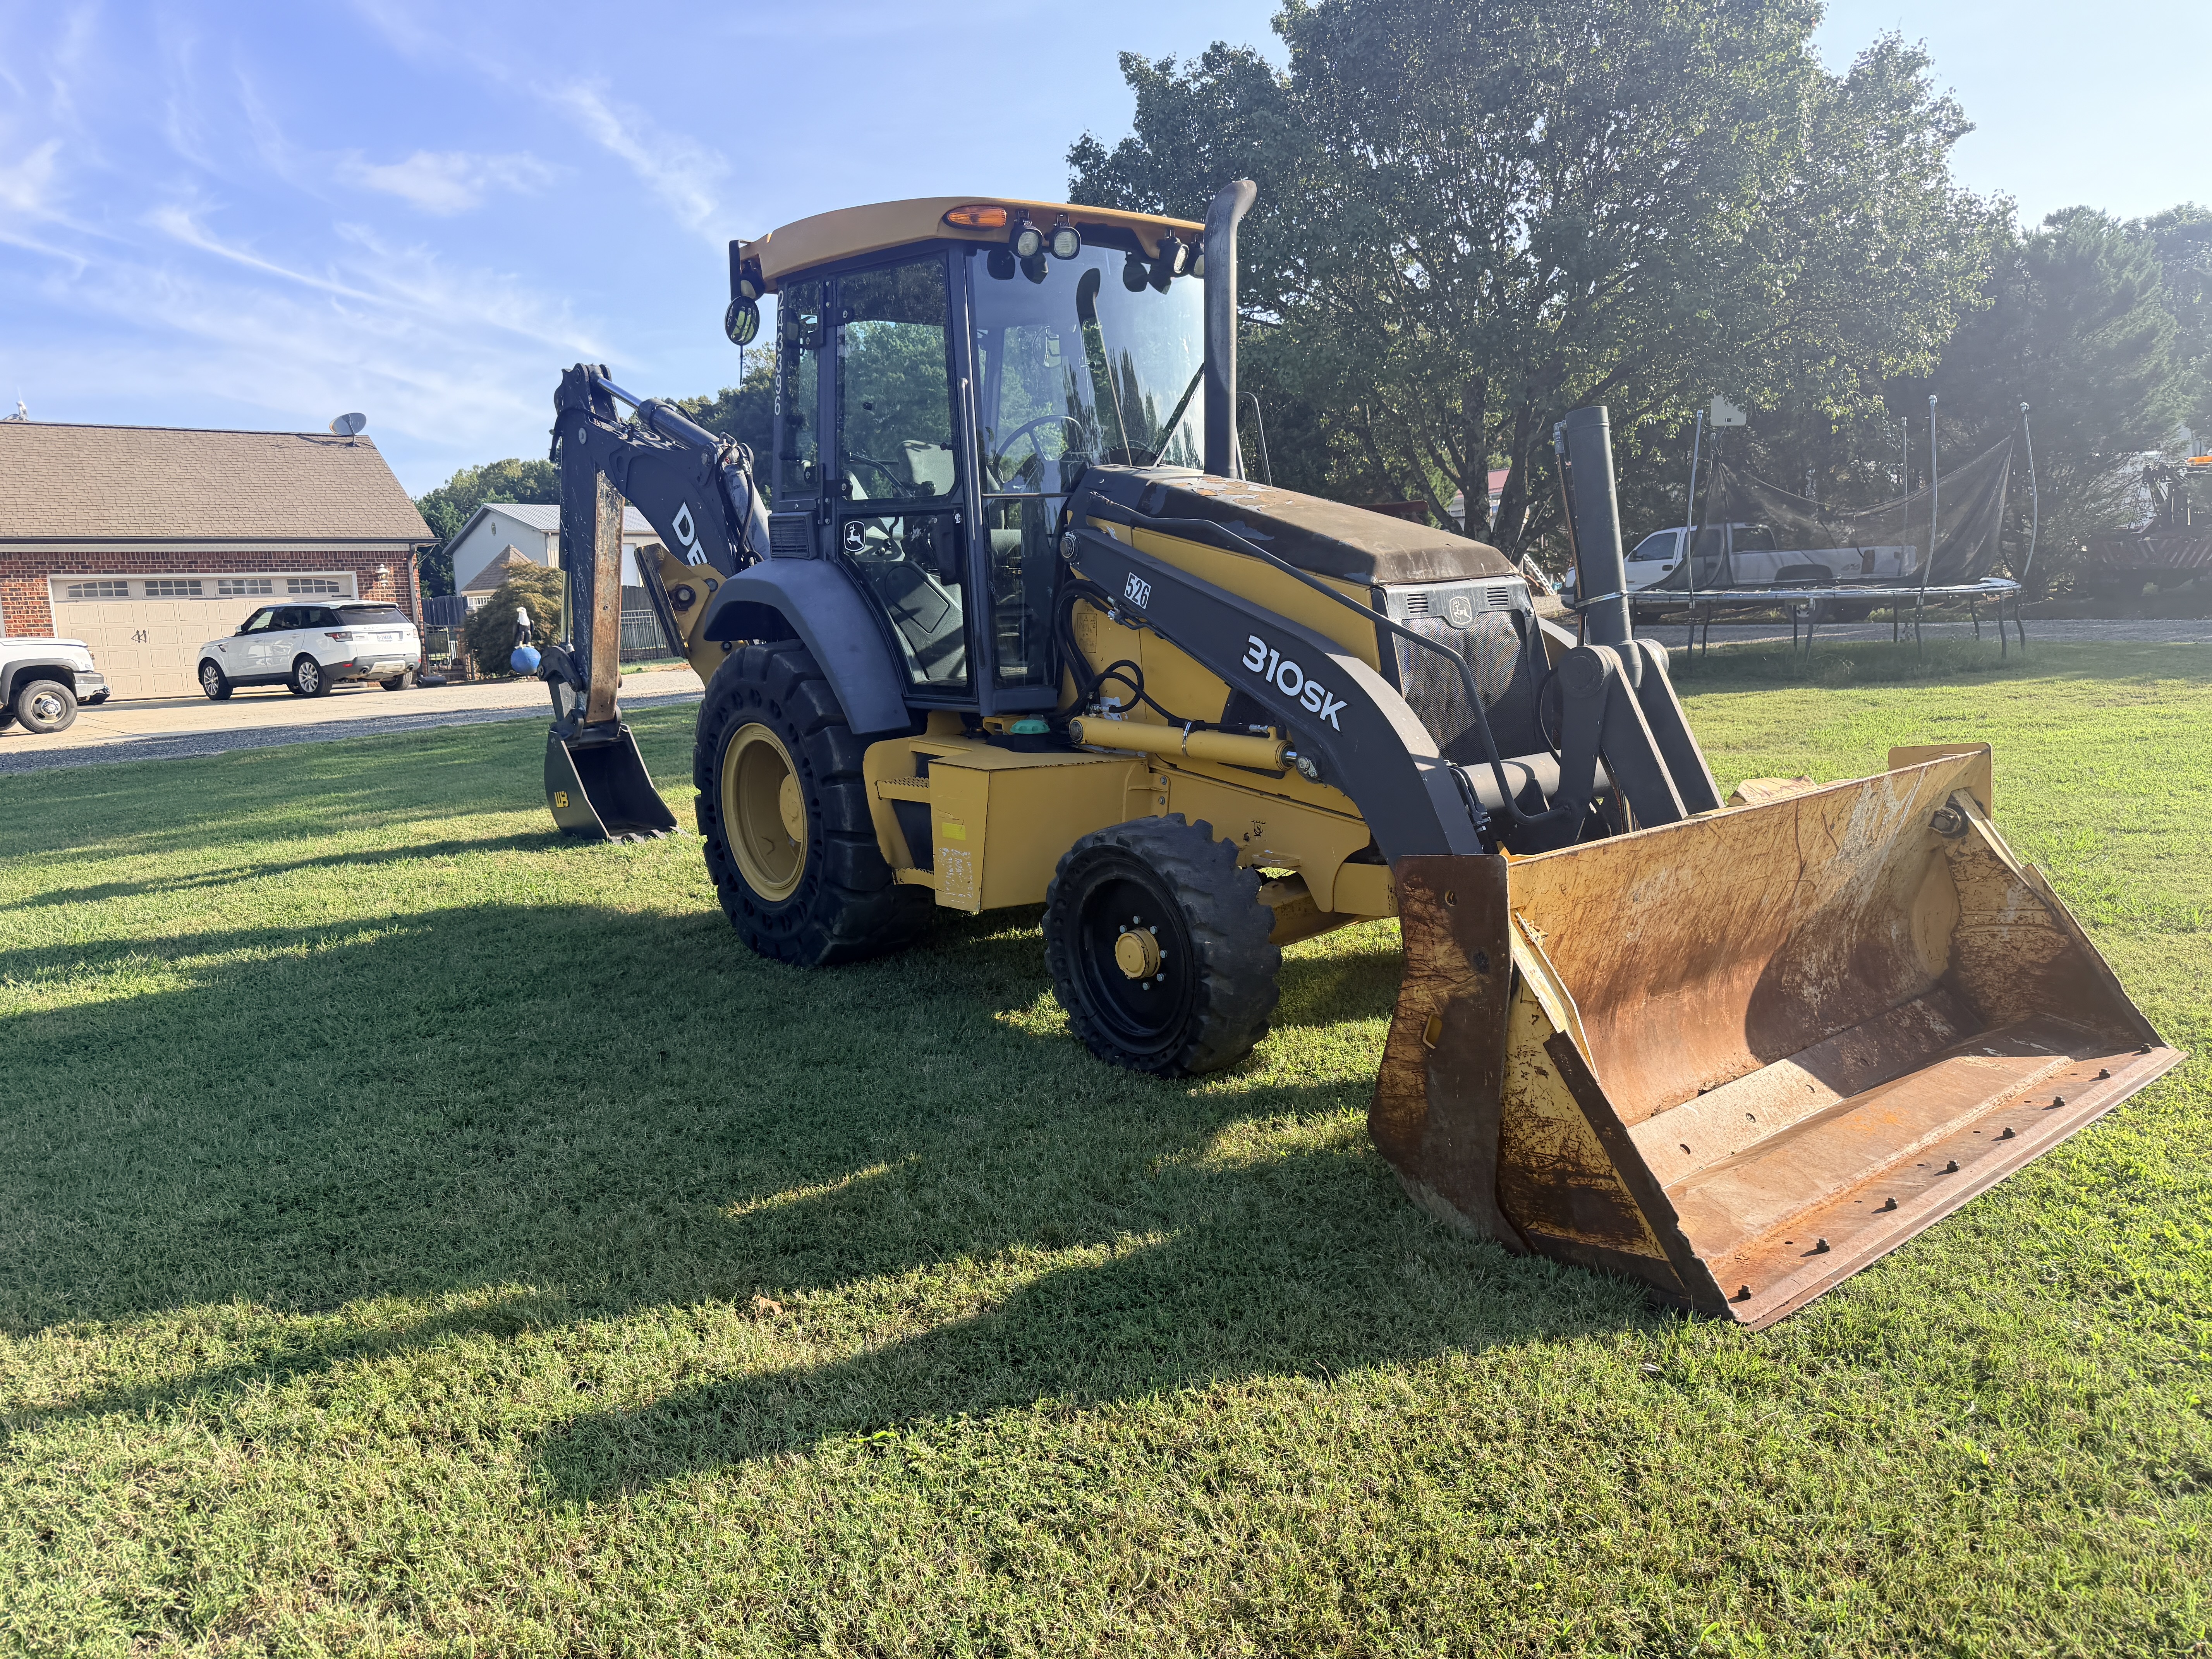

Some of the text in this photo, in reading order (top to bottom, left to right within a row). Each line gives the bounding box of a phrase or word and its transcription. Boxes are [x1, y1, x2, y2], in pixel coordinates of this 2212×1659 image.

[775, 290, 784, 416] 243396
[1126, 574, 1149, 607] 526
[1243, 635, 1348, 732] 310SK
